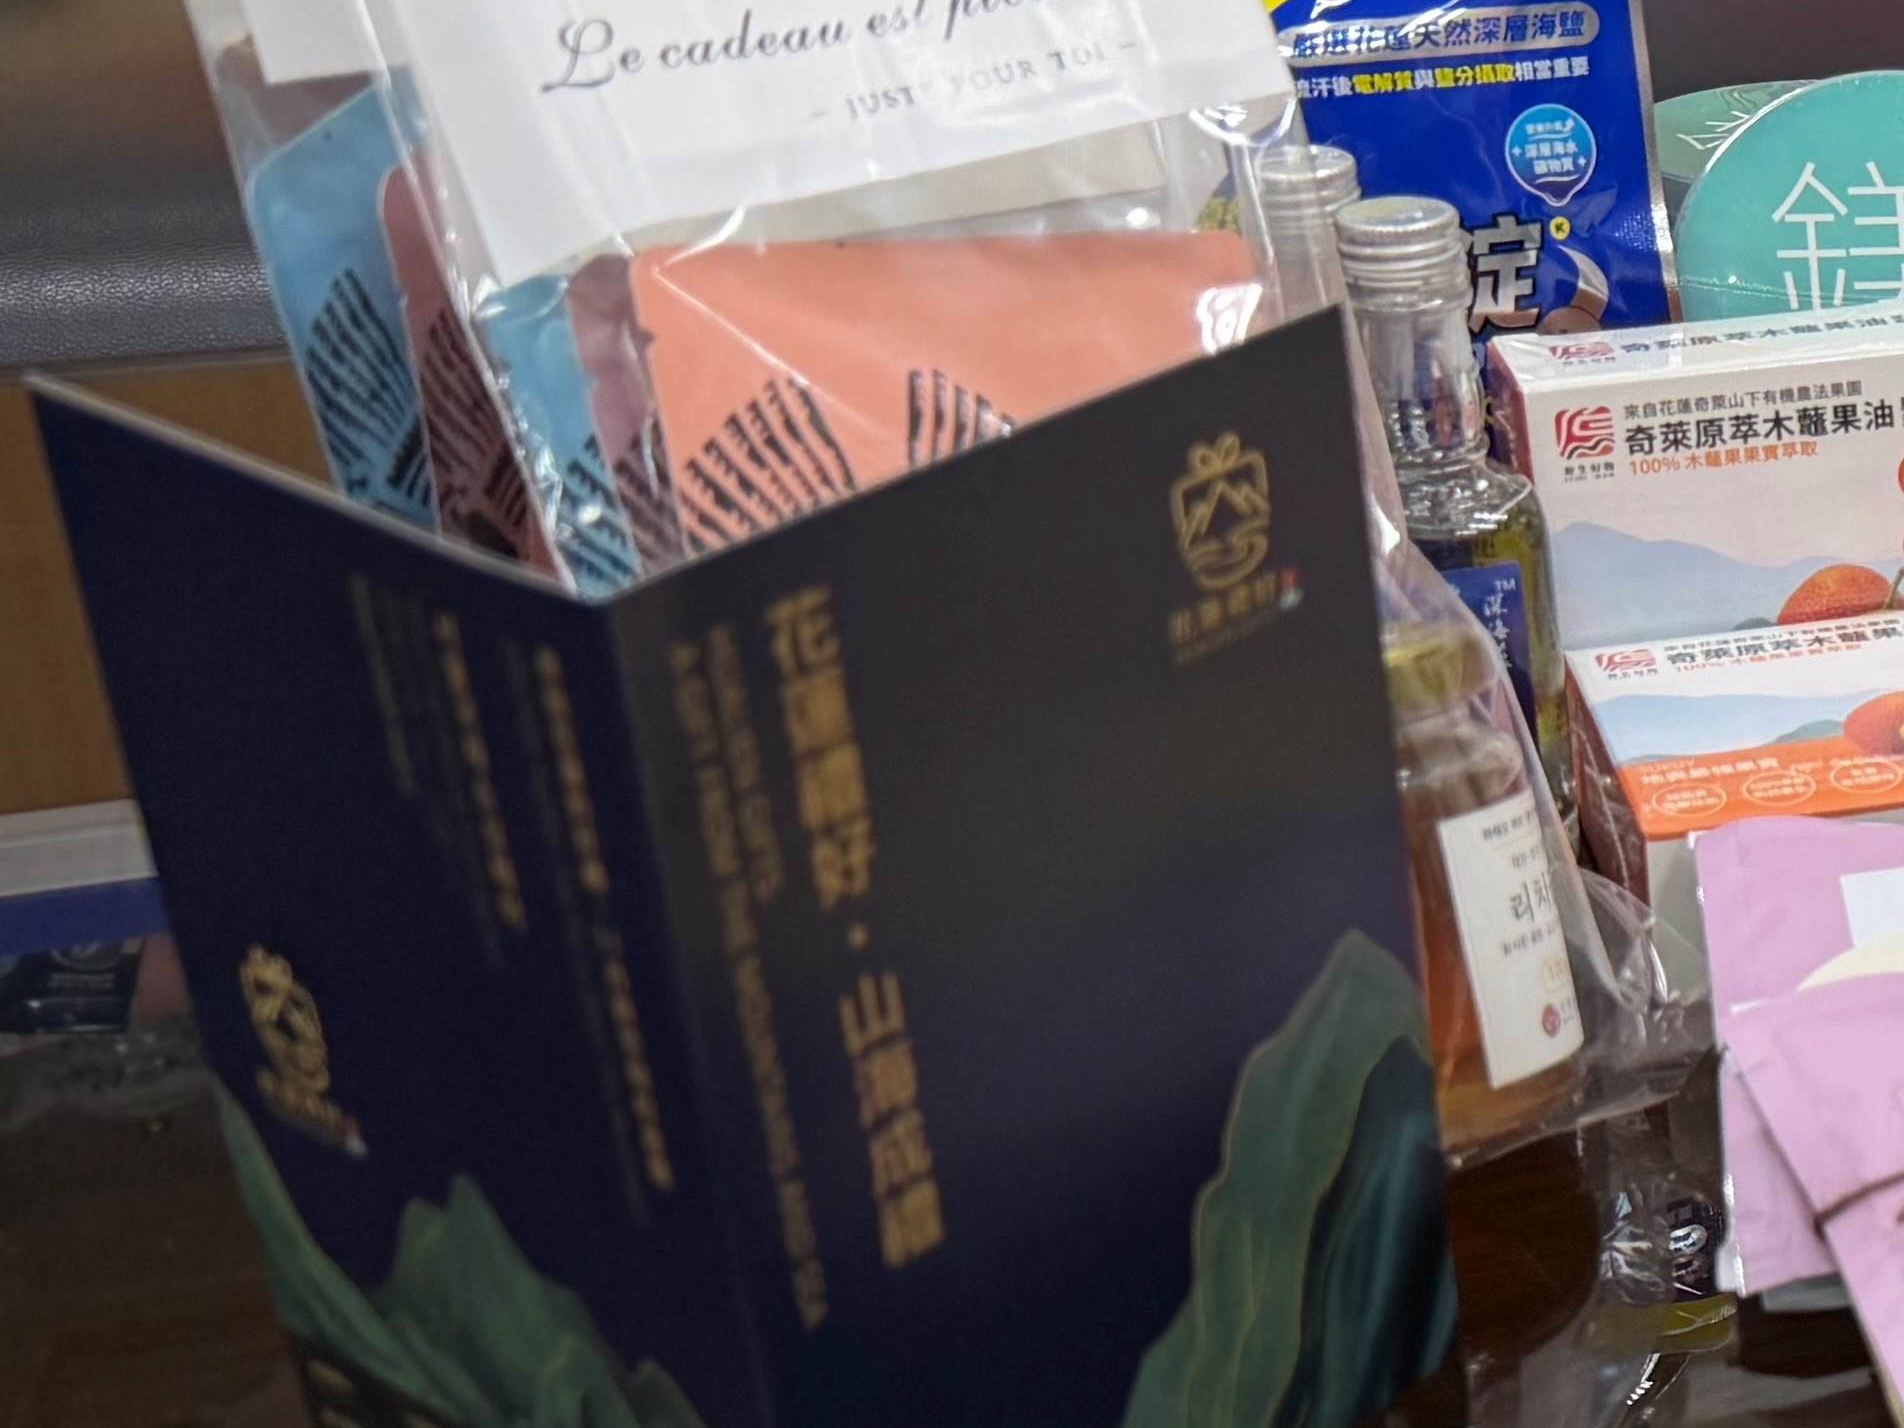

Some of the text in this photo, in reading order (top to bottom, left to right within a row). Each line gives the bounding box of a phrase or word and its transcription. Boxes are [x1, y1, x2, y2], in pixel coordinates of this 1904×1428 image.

[538, 17, 642, 95] Le
[658, 5, 853, 74] cadeau
[843, 83, 917, 123] JUST
[1628, 455, 1681, 476] 100%
